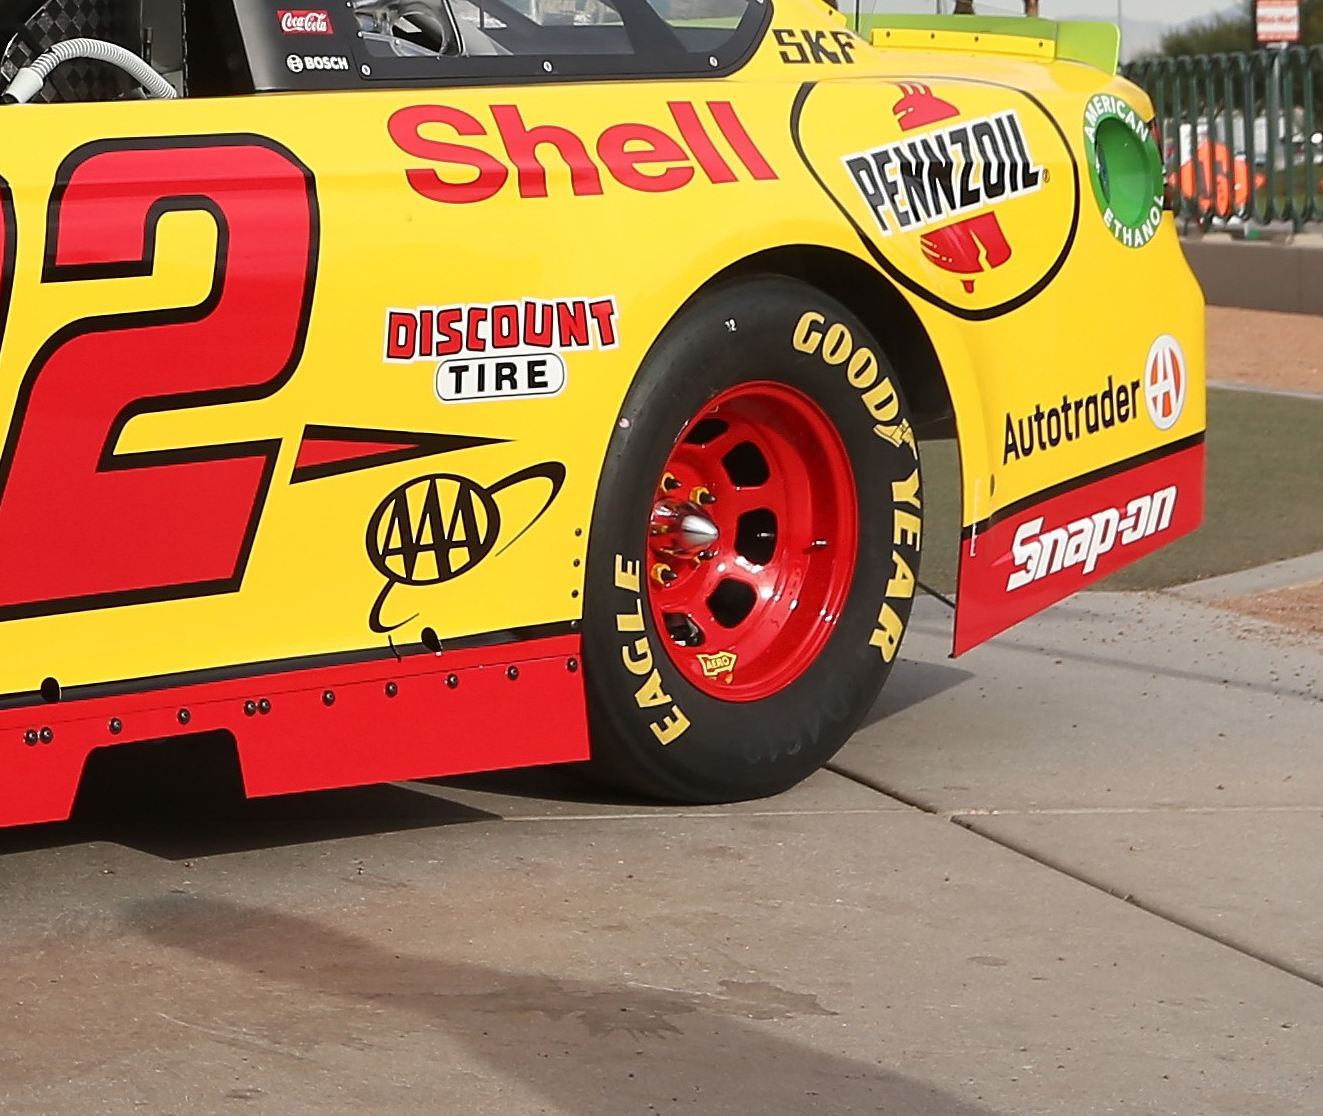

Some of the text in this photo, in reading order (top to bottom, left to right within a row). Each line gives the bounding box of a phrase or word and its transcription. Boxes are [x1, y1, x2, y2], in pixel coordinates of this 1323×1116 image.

[303, 55, 349, 71] BOSCH
[772, 28, 855, 65] SKF
[1084, 95, 1149, 144] AMERICAN
[386, 100, 779, 205] Shell
[844, 111, 1041, 233] PENNZOIL
[1103, 194, 1164, 247] ETHANOL
[385, 299, 617, 361] DISCOUNT
[448, 359, 549, 396] TIRE
[1002, 375, 1142, 467] Autotrader
[376, 476, 486, 581] AAA
[1005, 484, 1178, 593] Snap-on
[614, 553, 691, 747] EAGLE
[705, 656, 730, 672] AERO
